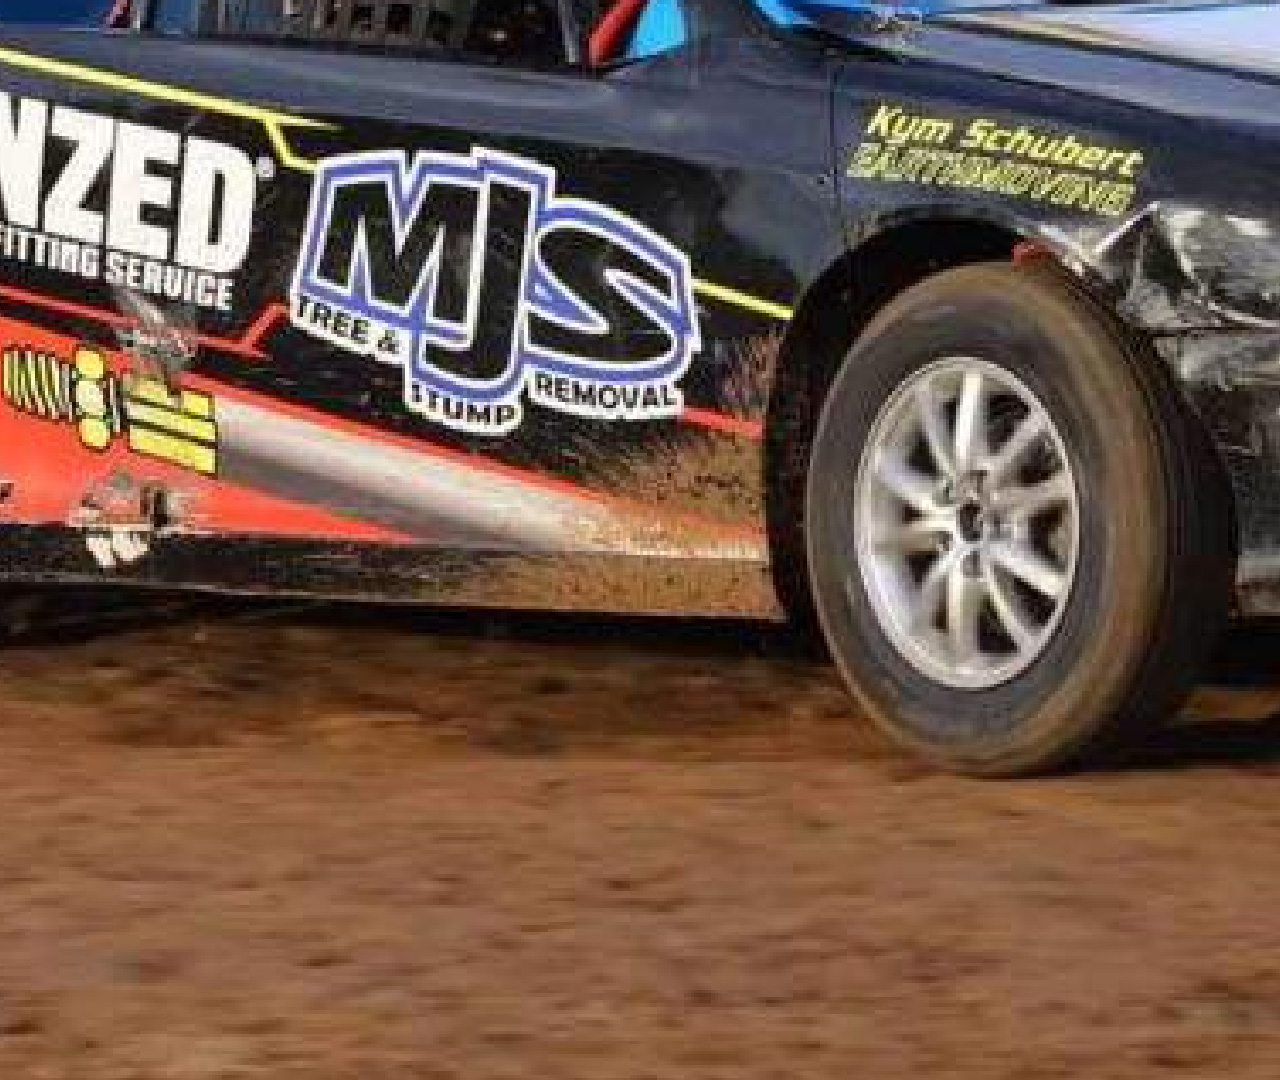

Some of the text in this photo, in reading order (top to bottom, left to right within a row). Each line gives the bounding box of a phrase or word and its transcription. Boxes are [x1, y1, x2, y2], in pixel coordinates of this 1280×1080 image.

[867, 105, 1144, 177] Kym Schubert
[105, 250, 234, 312] SERVICE
[310, 168, 688, 386] MJS
[296, 295, 371, 345] TREE
[537, 374, 679, 411] REMOVAL
